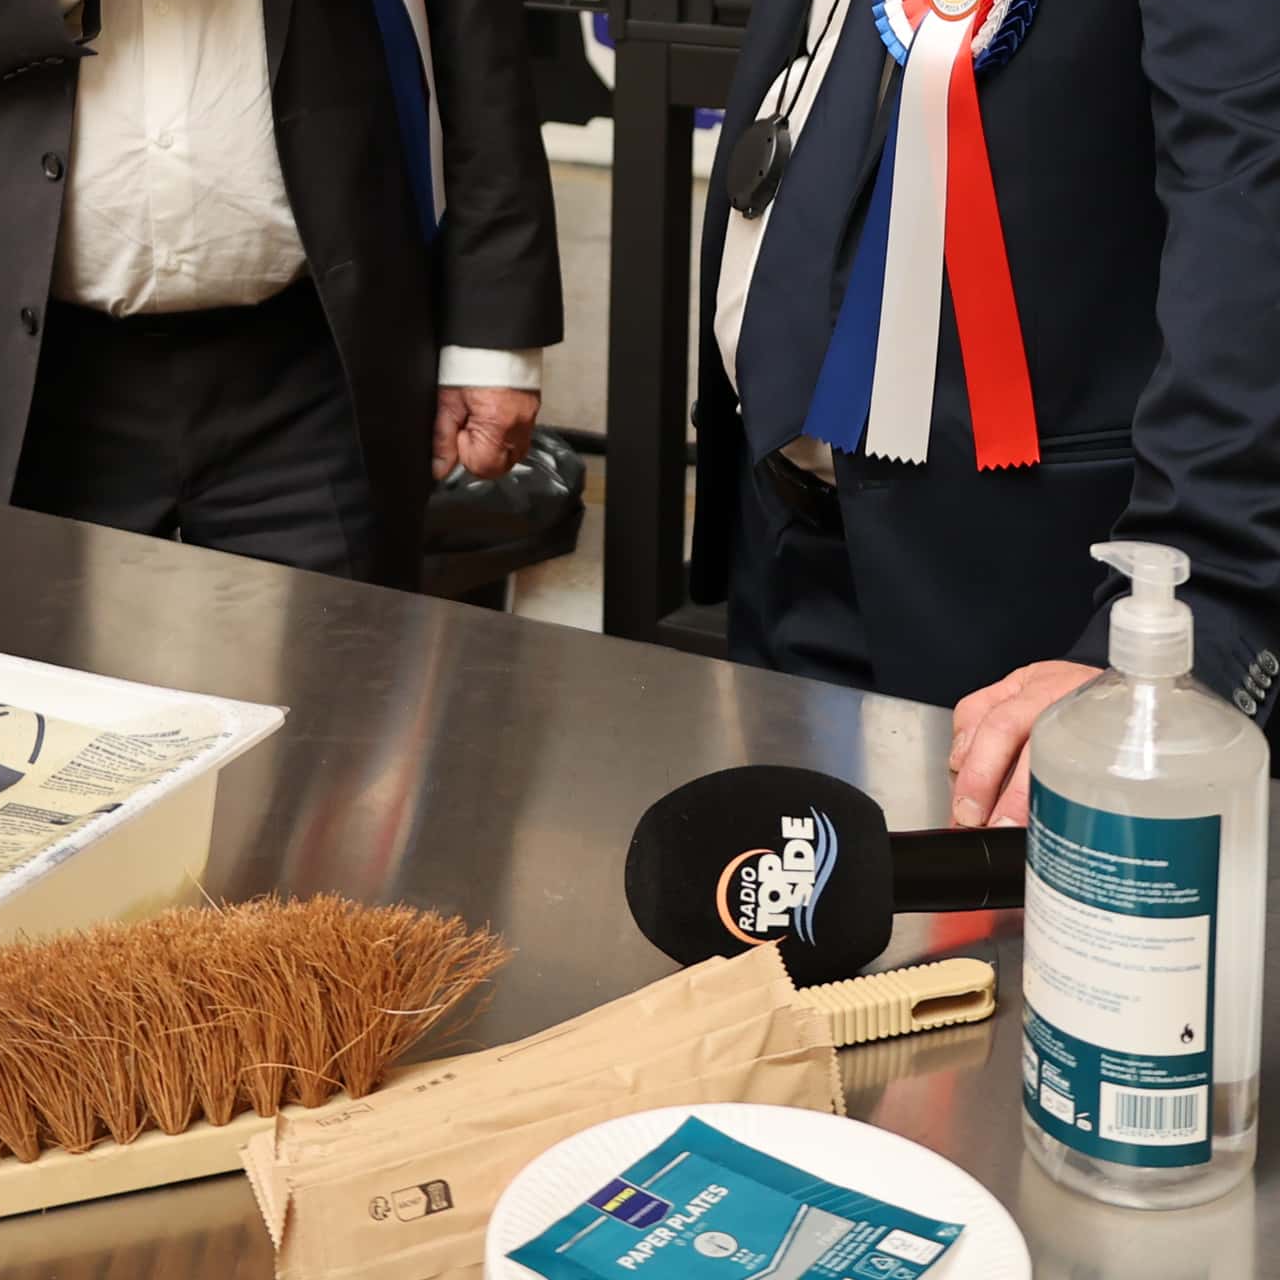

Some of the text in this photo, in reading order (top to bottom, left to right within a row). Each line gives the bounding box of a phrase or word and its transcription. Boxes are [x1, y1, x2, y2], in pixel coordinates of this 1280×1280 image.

[739, 866, 758, 932] RADIO
[756, 853, 790, 933] TOP
[781, 816, 816, 907] SIDE
[616, 1227, 677, 1269] PAPER
[666, 1184, 729, 1230] PLATES
